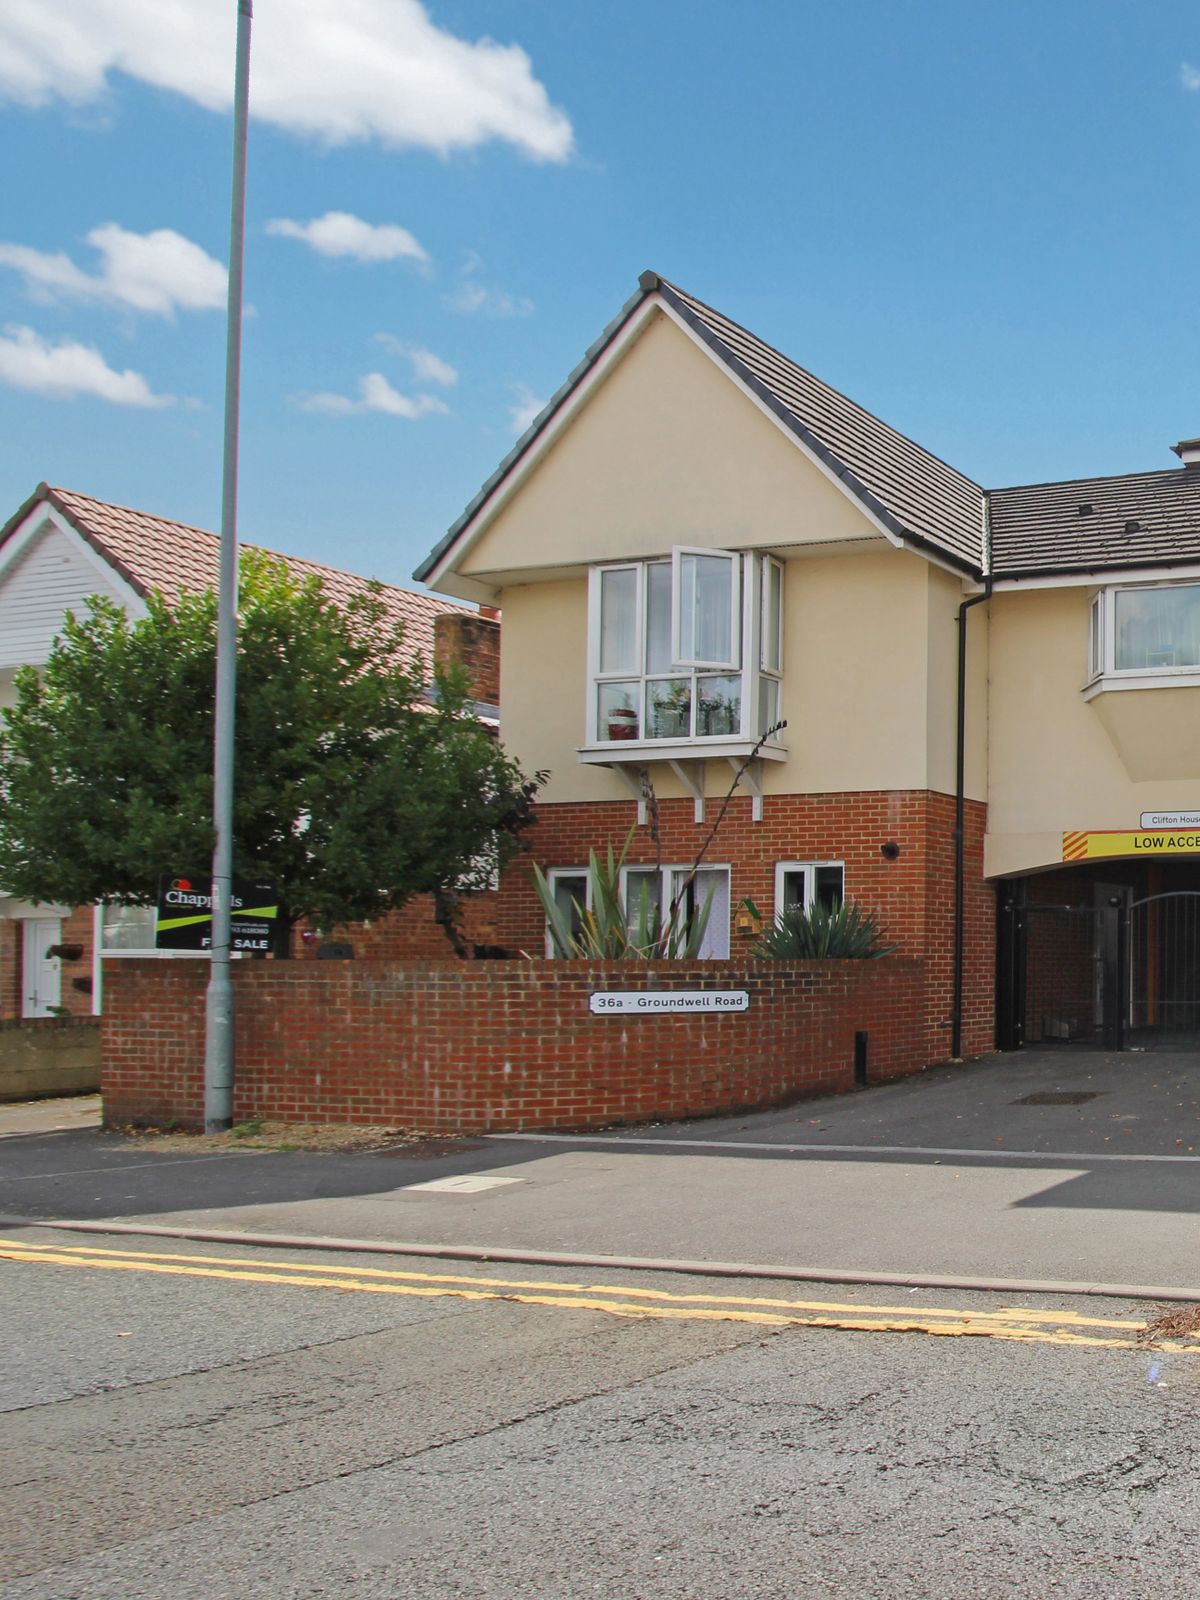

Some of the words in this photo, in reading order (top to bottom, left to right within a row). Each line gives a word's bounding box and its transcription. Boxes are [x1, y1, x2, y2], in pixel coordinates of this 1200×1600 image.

[1151, 815, 1178, 824] Clifton
[1134, 836, 1165, 848] LOW
[165, 891, 243, 908] Chapls
[234, 939, 269, 949] SALE
[598, 998, 624, 1008] 36a
[637, 997, 710, 1008] Groundwell
[714, 996, 743, 1006] Road
